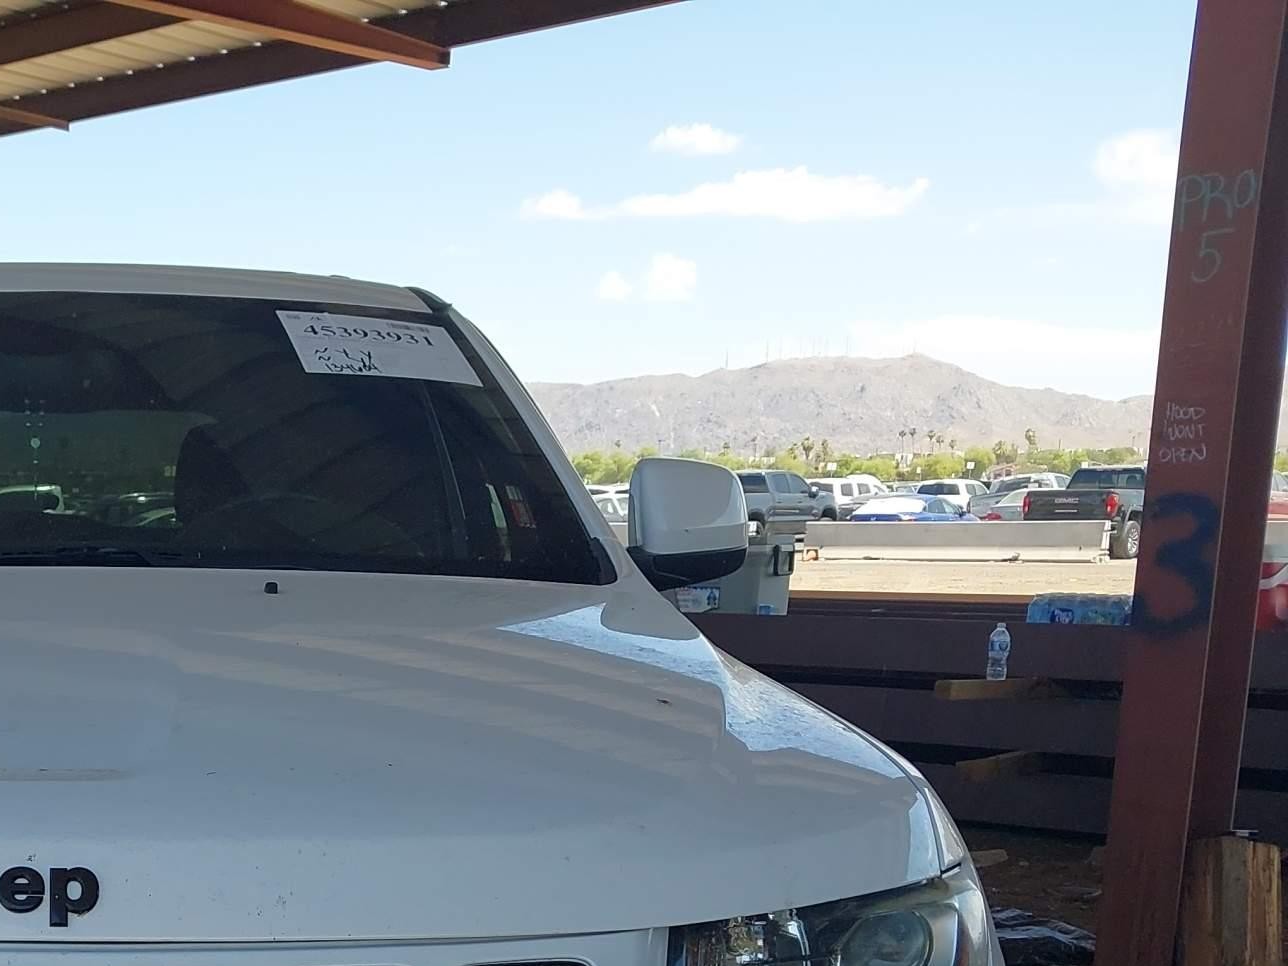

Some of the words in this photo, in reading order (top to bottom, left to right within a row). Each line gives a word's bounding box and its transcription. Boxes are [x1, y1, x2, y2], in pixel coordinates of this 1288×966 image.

[1178, 168, 1257, 232] PRO
[1191, 228, 1236, 283] 5
[303, 324, 435, 347] 45393931
[1159, 443, 1207, 464] OPEN
[1132, 491, 1219, 639] 3
